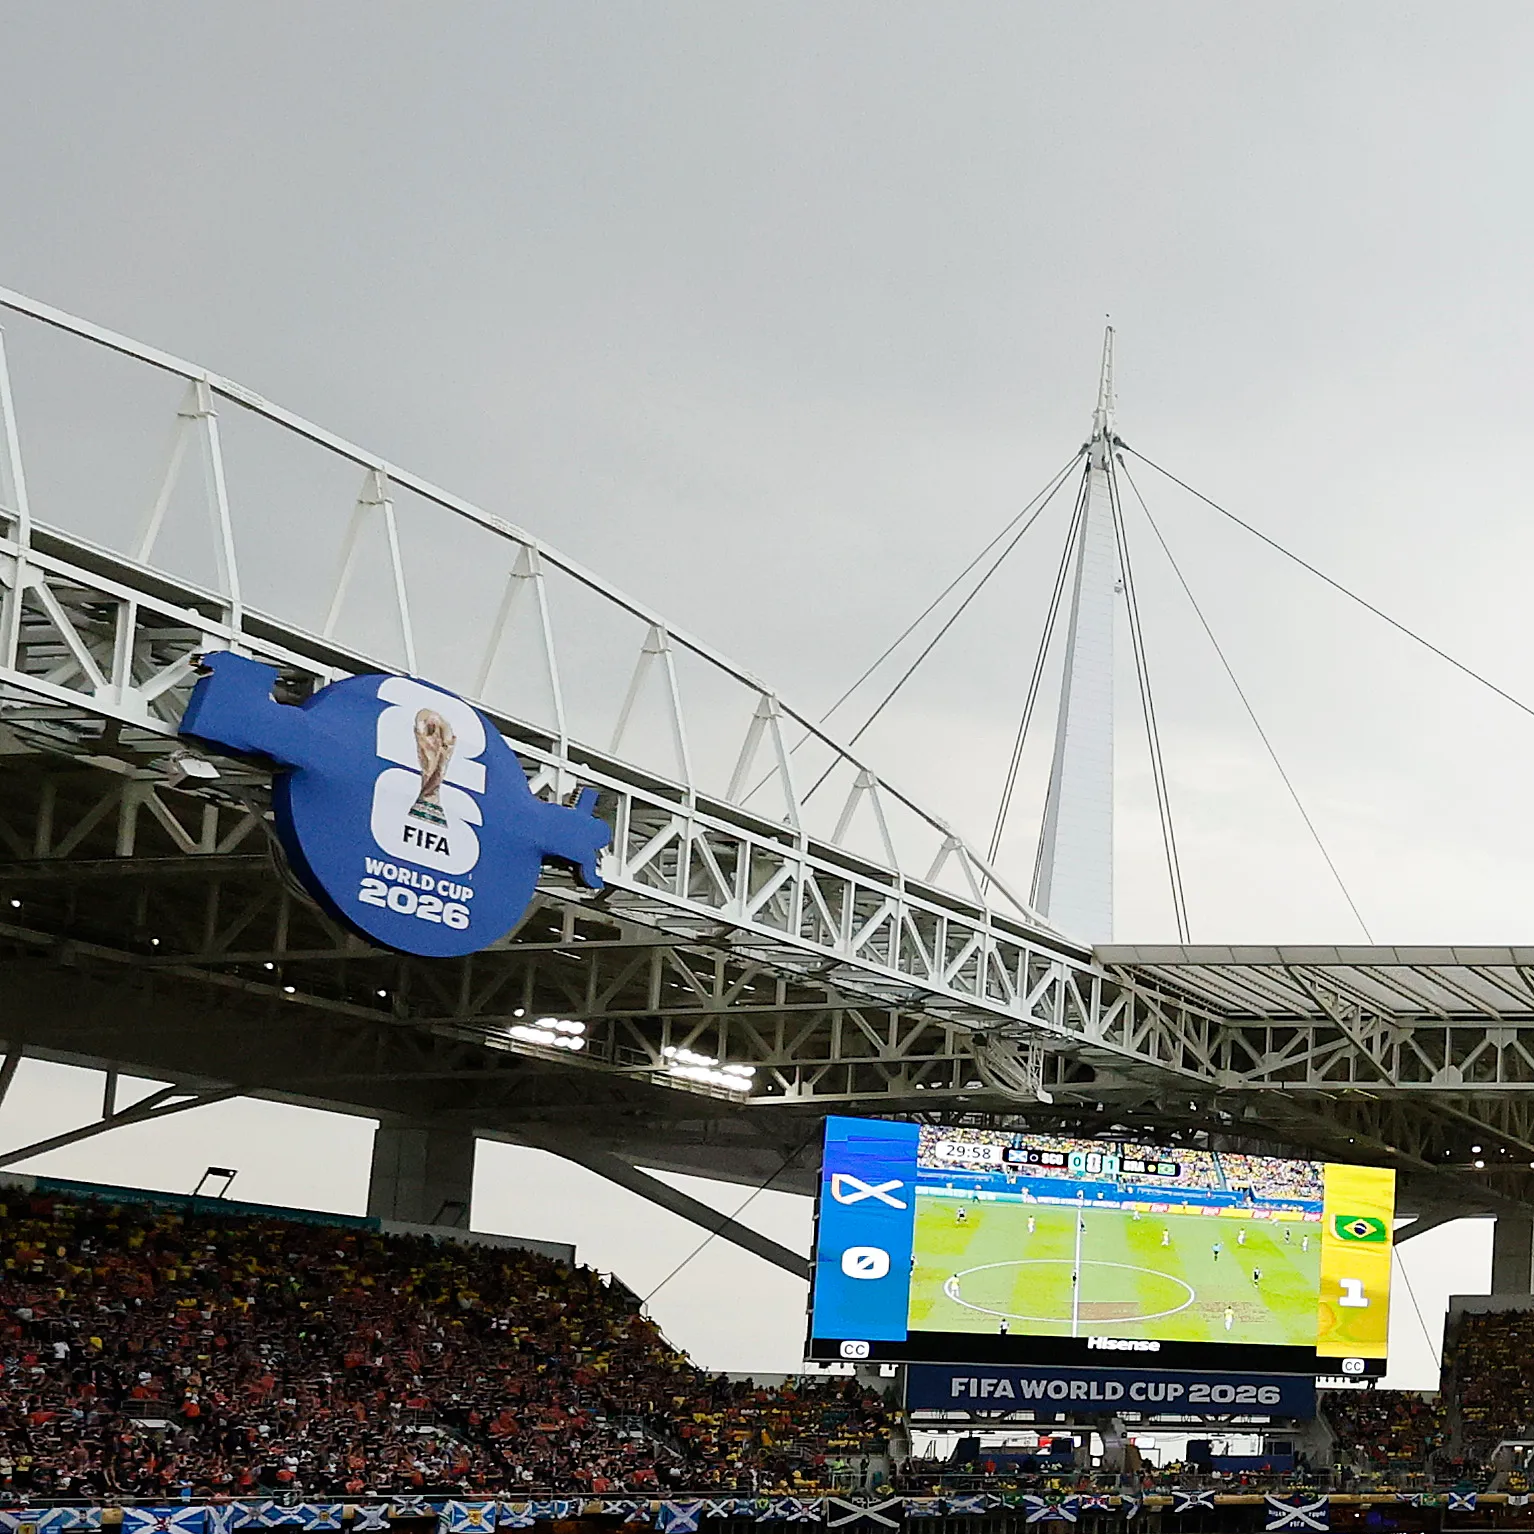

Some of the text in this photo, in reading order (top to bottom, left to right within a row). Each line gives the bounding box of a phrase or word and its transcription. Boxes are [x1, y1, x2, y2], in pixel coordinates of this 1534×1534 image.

[403, 825, 450, 857] FIFA
[365, 856, 475, 903] WORLD CUP
[358, 878, 471, 931] 2026
[945, 1143, 993, 1162] 29:58
[1073, 1156, 1081, 1167] 0
[841, 1246, 891, 1280] 0
[1339, 1278, 1369, 1308] 1
[843, 1344, 866, 1356] CC
[1087, 1336, 1161, 1353] Hisense
[951, 1377, 1281, 1405] FIFA WORLD CUP 2026
